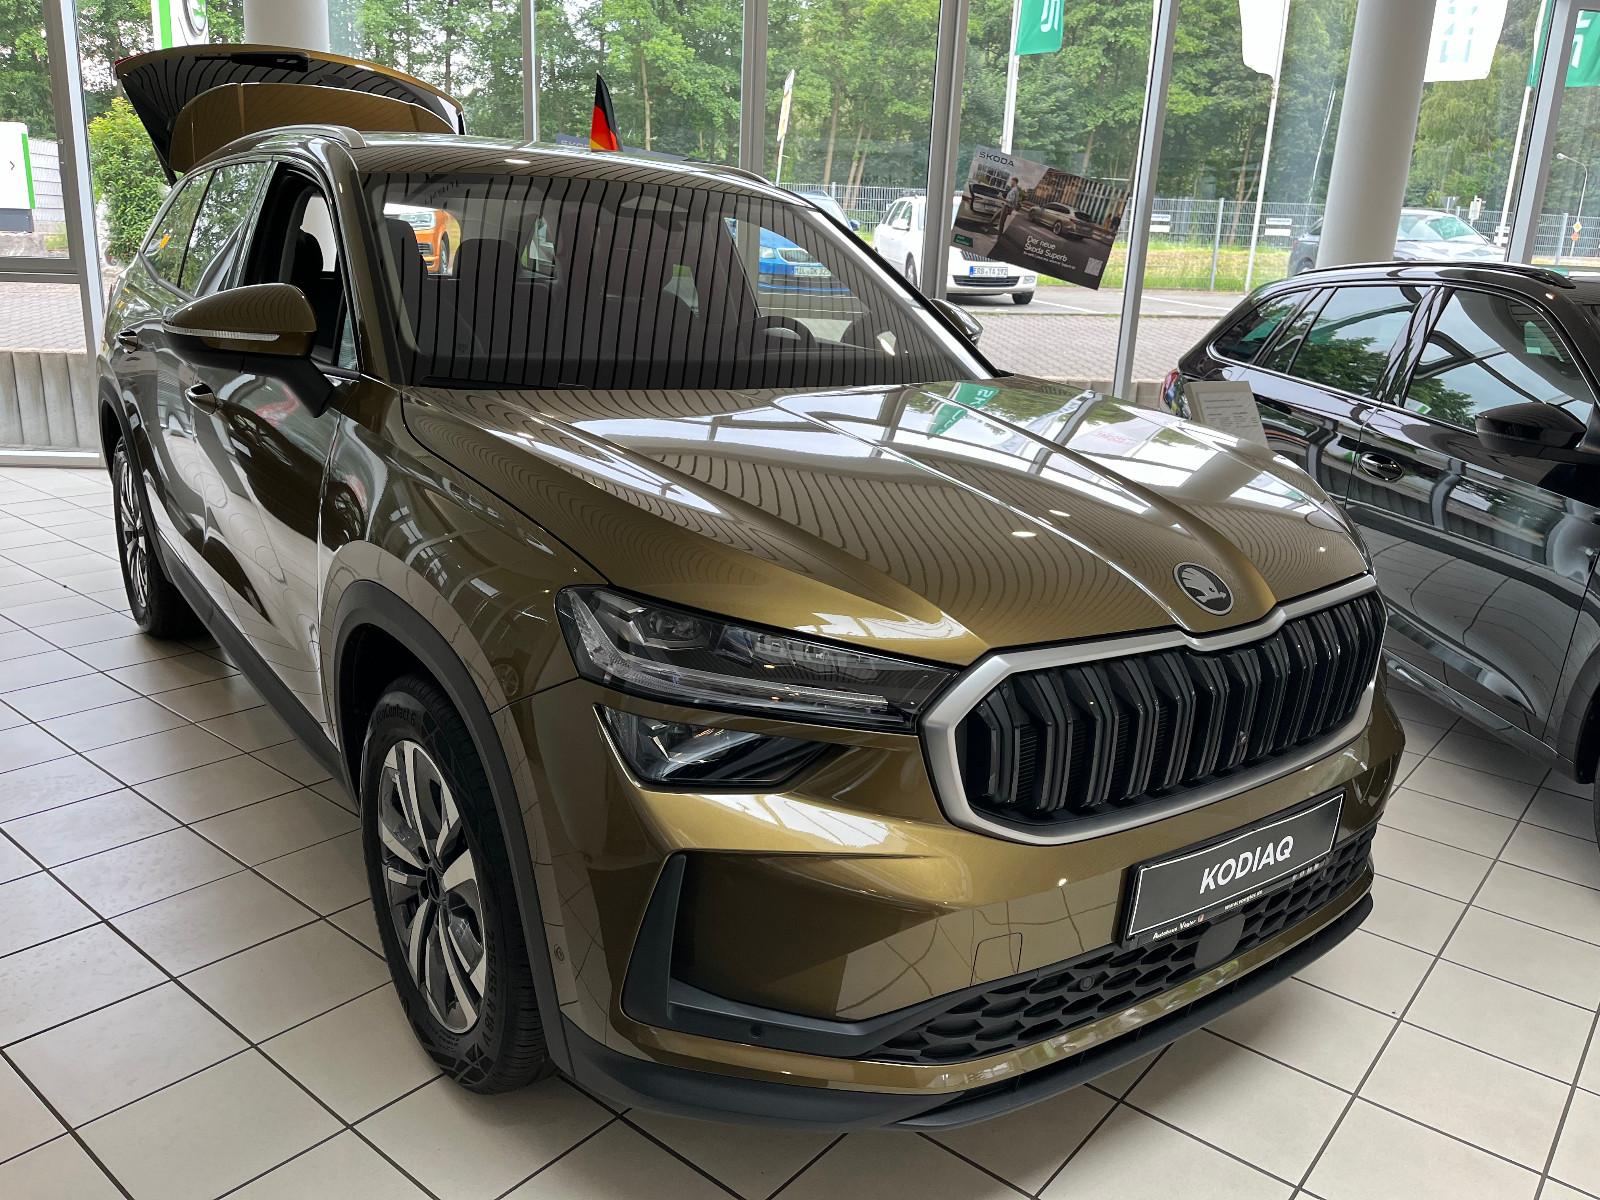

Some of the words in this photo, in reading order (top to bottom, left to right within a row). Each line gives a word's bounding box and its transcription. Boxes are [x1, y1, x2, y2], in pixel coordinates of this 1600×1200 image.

[1027, 235, 1039, 245] Der
[1040, 240, 1056, 250] neue
[1045, 249, 1068, 262] Superb
[1199, 835, 1294, 894] KODIAQ
